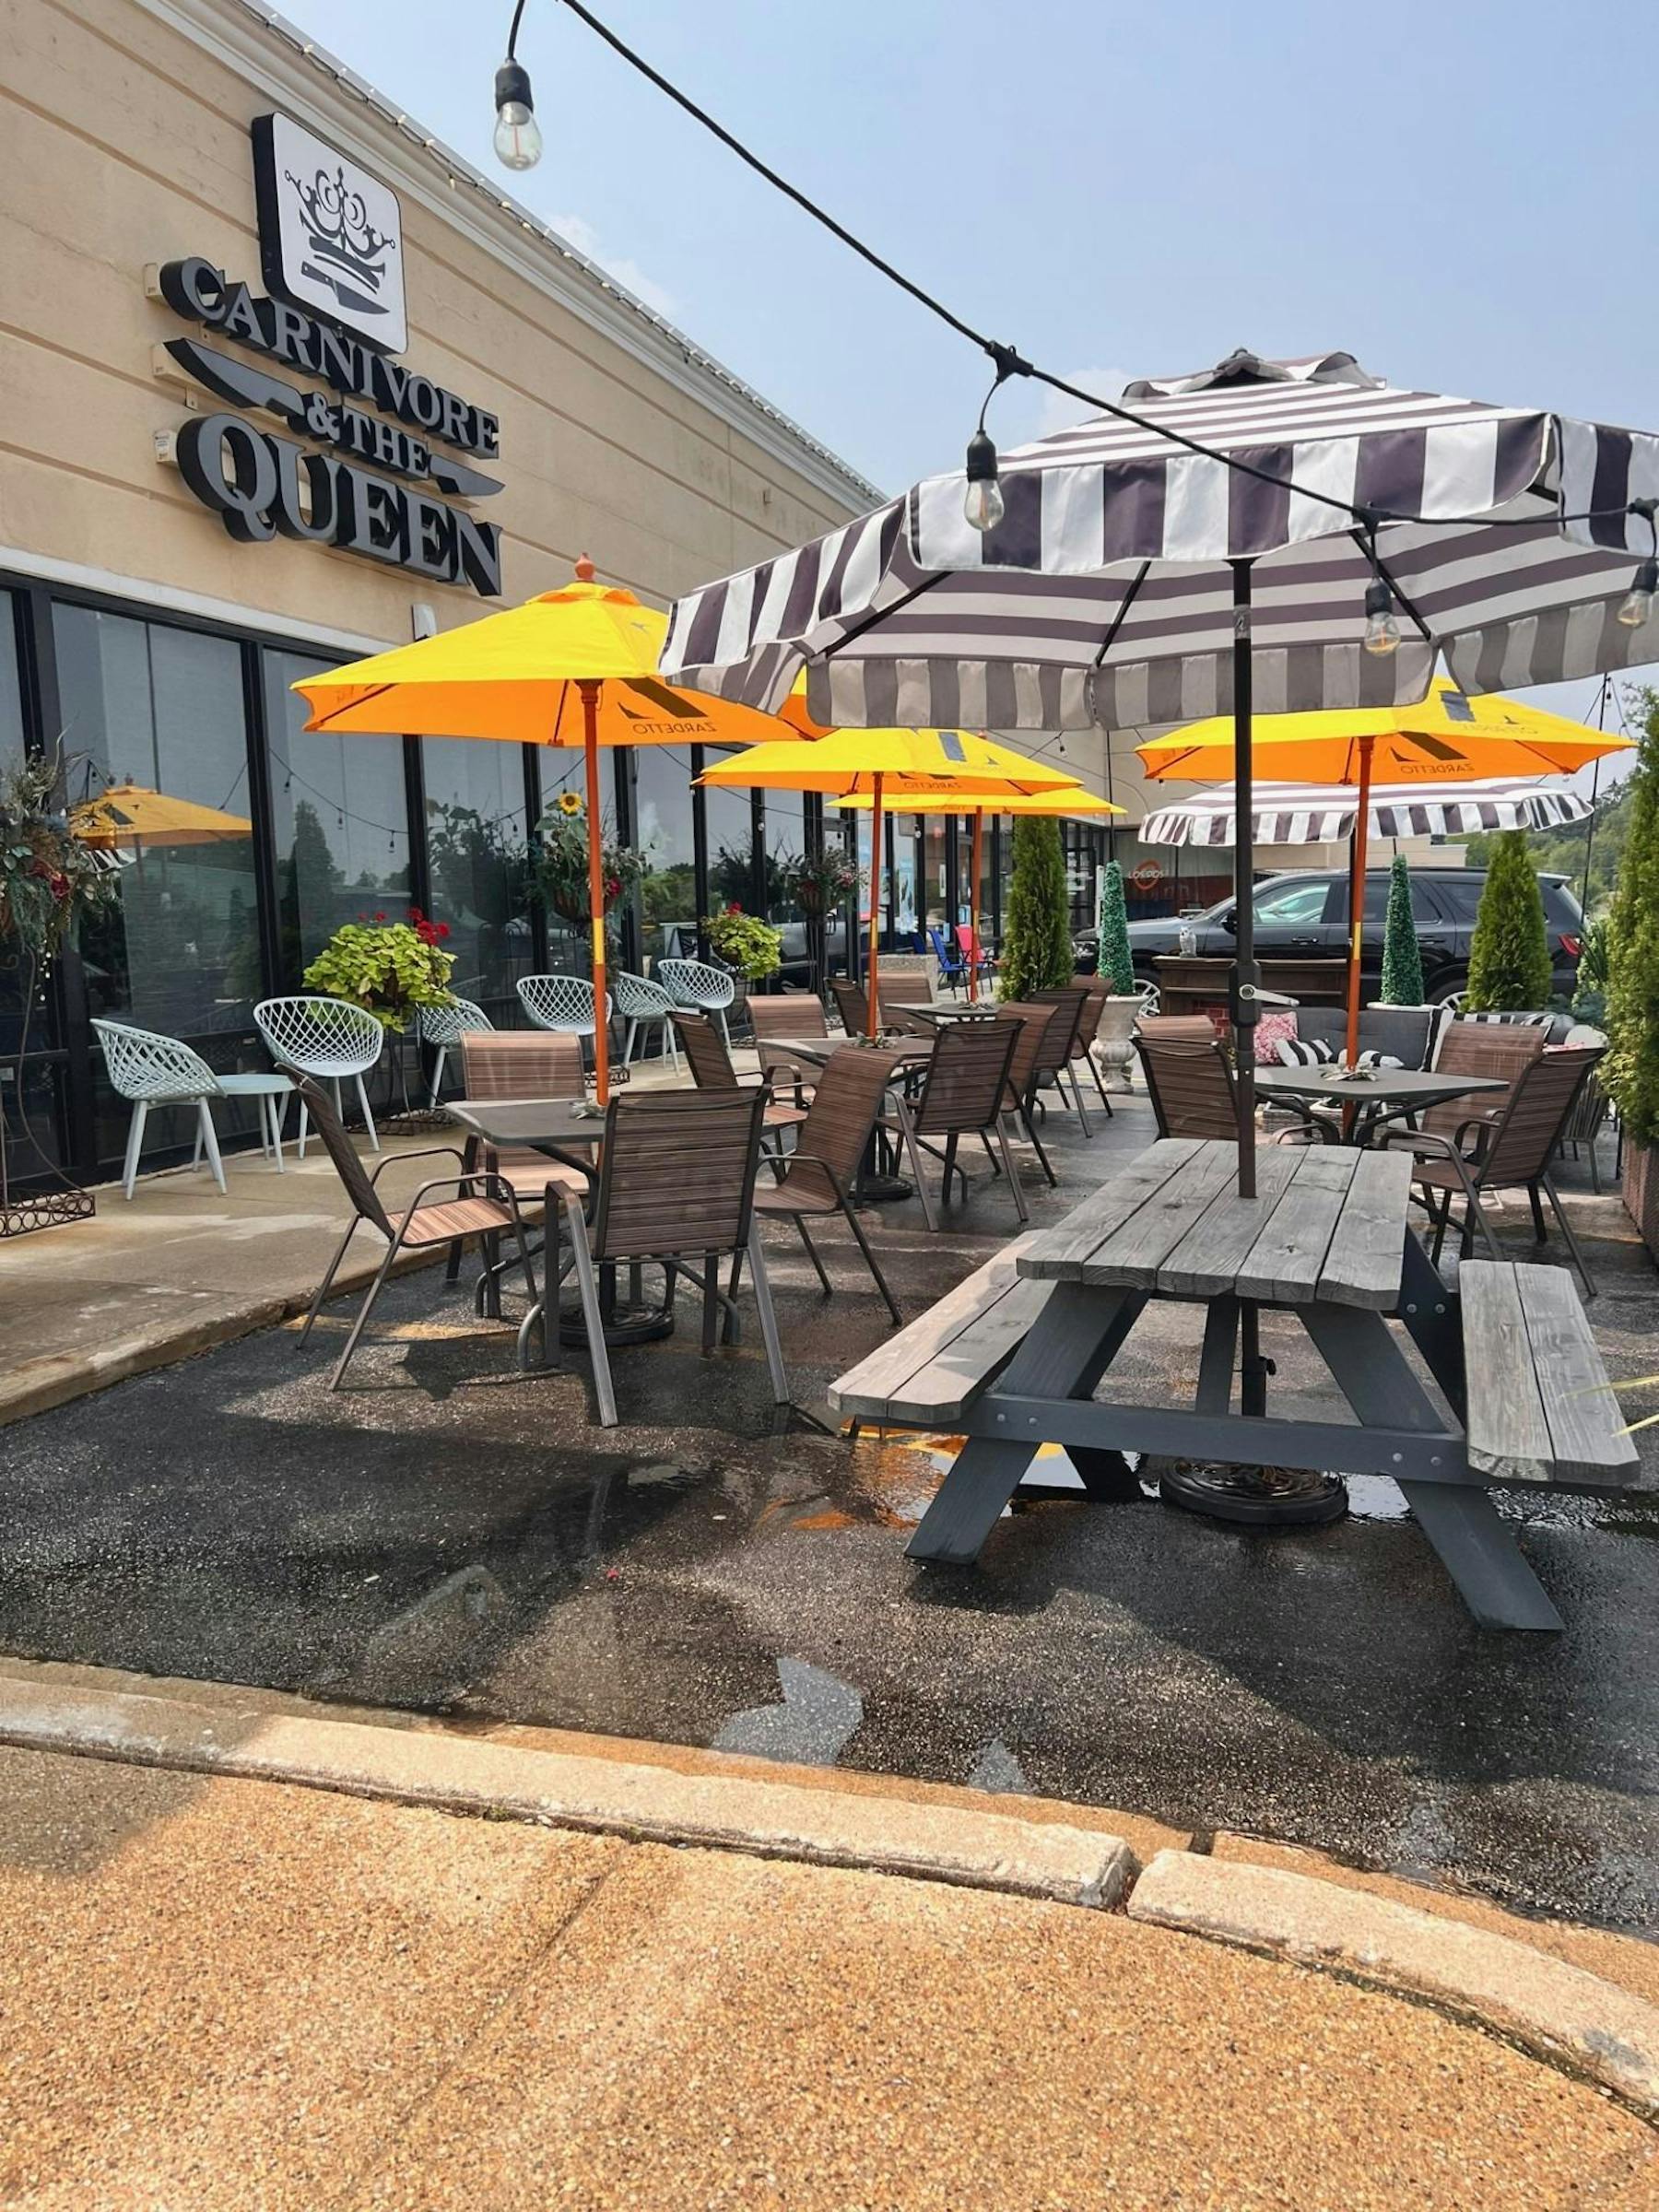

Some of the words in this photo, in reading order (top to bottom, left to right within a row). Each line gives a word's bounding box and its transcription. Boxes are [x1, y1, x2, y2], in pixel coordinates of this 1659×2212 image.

[160, 256, 500, 459] CARNIVORE
[305, 392, 337, 441] &
[341, 404, 430, 478] THE
[176, 413, 502, 597] QUEEN
